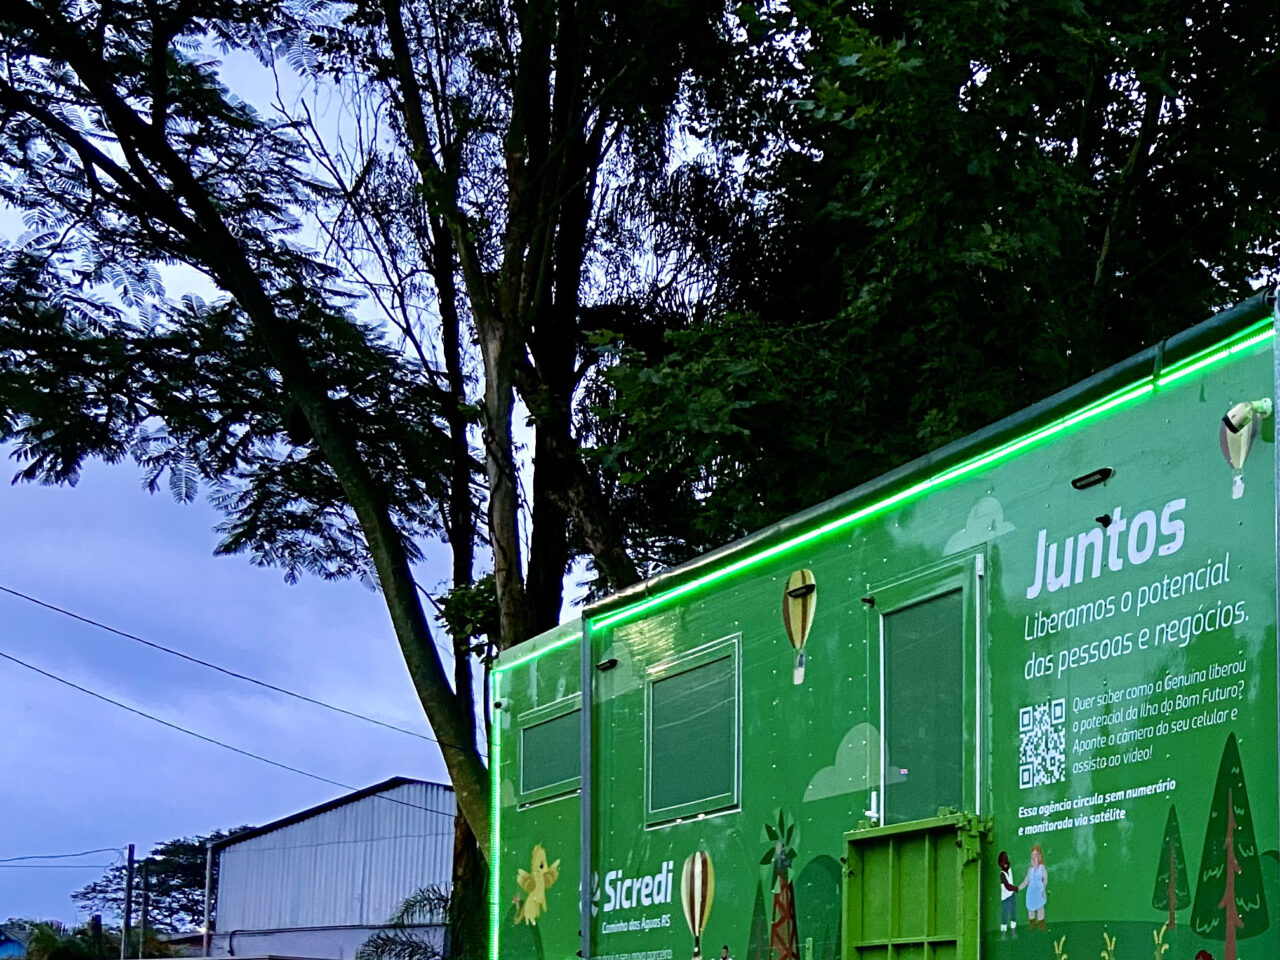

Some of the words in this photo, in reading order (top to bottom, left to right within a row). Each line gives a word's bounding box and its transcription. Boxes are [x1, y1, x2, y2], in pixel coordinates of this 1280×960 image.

[1026, 498, 1186, 600] Juntos
[1024, 596, 1116, 641] Liberamos
[1121, 591, 1132, 612] o
[1136, 552, 1230, 617] potencial
[1024, 652, 1054, 680] das
[1058, 633, 1133, 679] pessoas
[1138, 628, 1150, 649] e
[1154, 600, 1249, 648] negócios.
[1072, 696, 1095, 714] Quer
[1096, 690, 1124, 706] saber
[1126, 683, 1154, 699] como
[1155, 680, 1163, 692] a
[1208, 659, 1247, 680] liberou
[1072, 721, 1079, 732] o
[1080, 709, 1124, 731] potencial
[1126, 704, 1138, 720] da
[1140, 700, 1159, 717] Ilha
[1160, 696, 1174, 712] do
[1175, 692, 1200, 710] Bom
[1202, 680, 1245, 704] Futuro?
[1072, 732, 1107, 754] Aponte
[1108, 735, 1116, 746] a
[1117, 724, 1154, 744] câmera
[1156, 720, 1169, 735] do
[1170, 717, 1189, 733] seu
[1191, 709, 1230, 728] celular
[1231, 710, 1239, 721] e
[1072, 755, 1107, 774] assista
[1108, 755, 1121, 767] ao
[1018, 805, 1037, 818] Essa
[1038, 798, 1072, 817] agência
[1073, 794, 1103, 810] circula
[1105, 790, 1125, 804] sem
[1126, 778, 1176, 801] numerário
[1025, 819, 1073, 835] monitorada
[1074, 816, 1088, 828] via
[1089, 808, 1126, 826] satélite
[603, 860, 674, 912] Sicredi
[661, 914, 671, 927] RS
